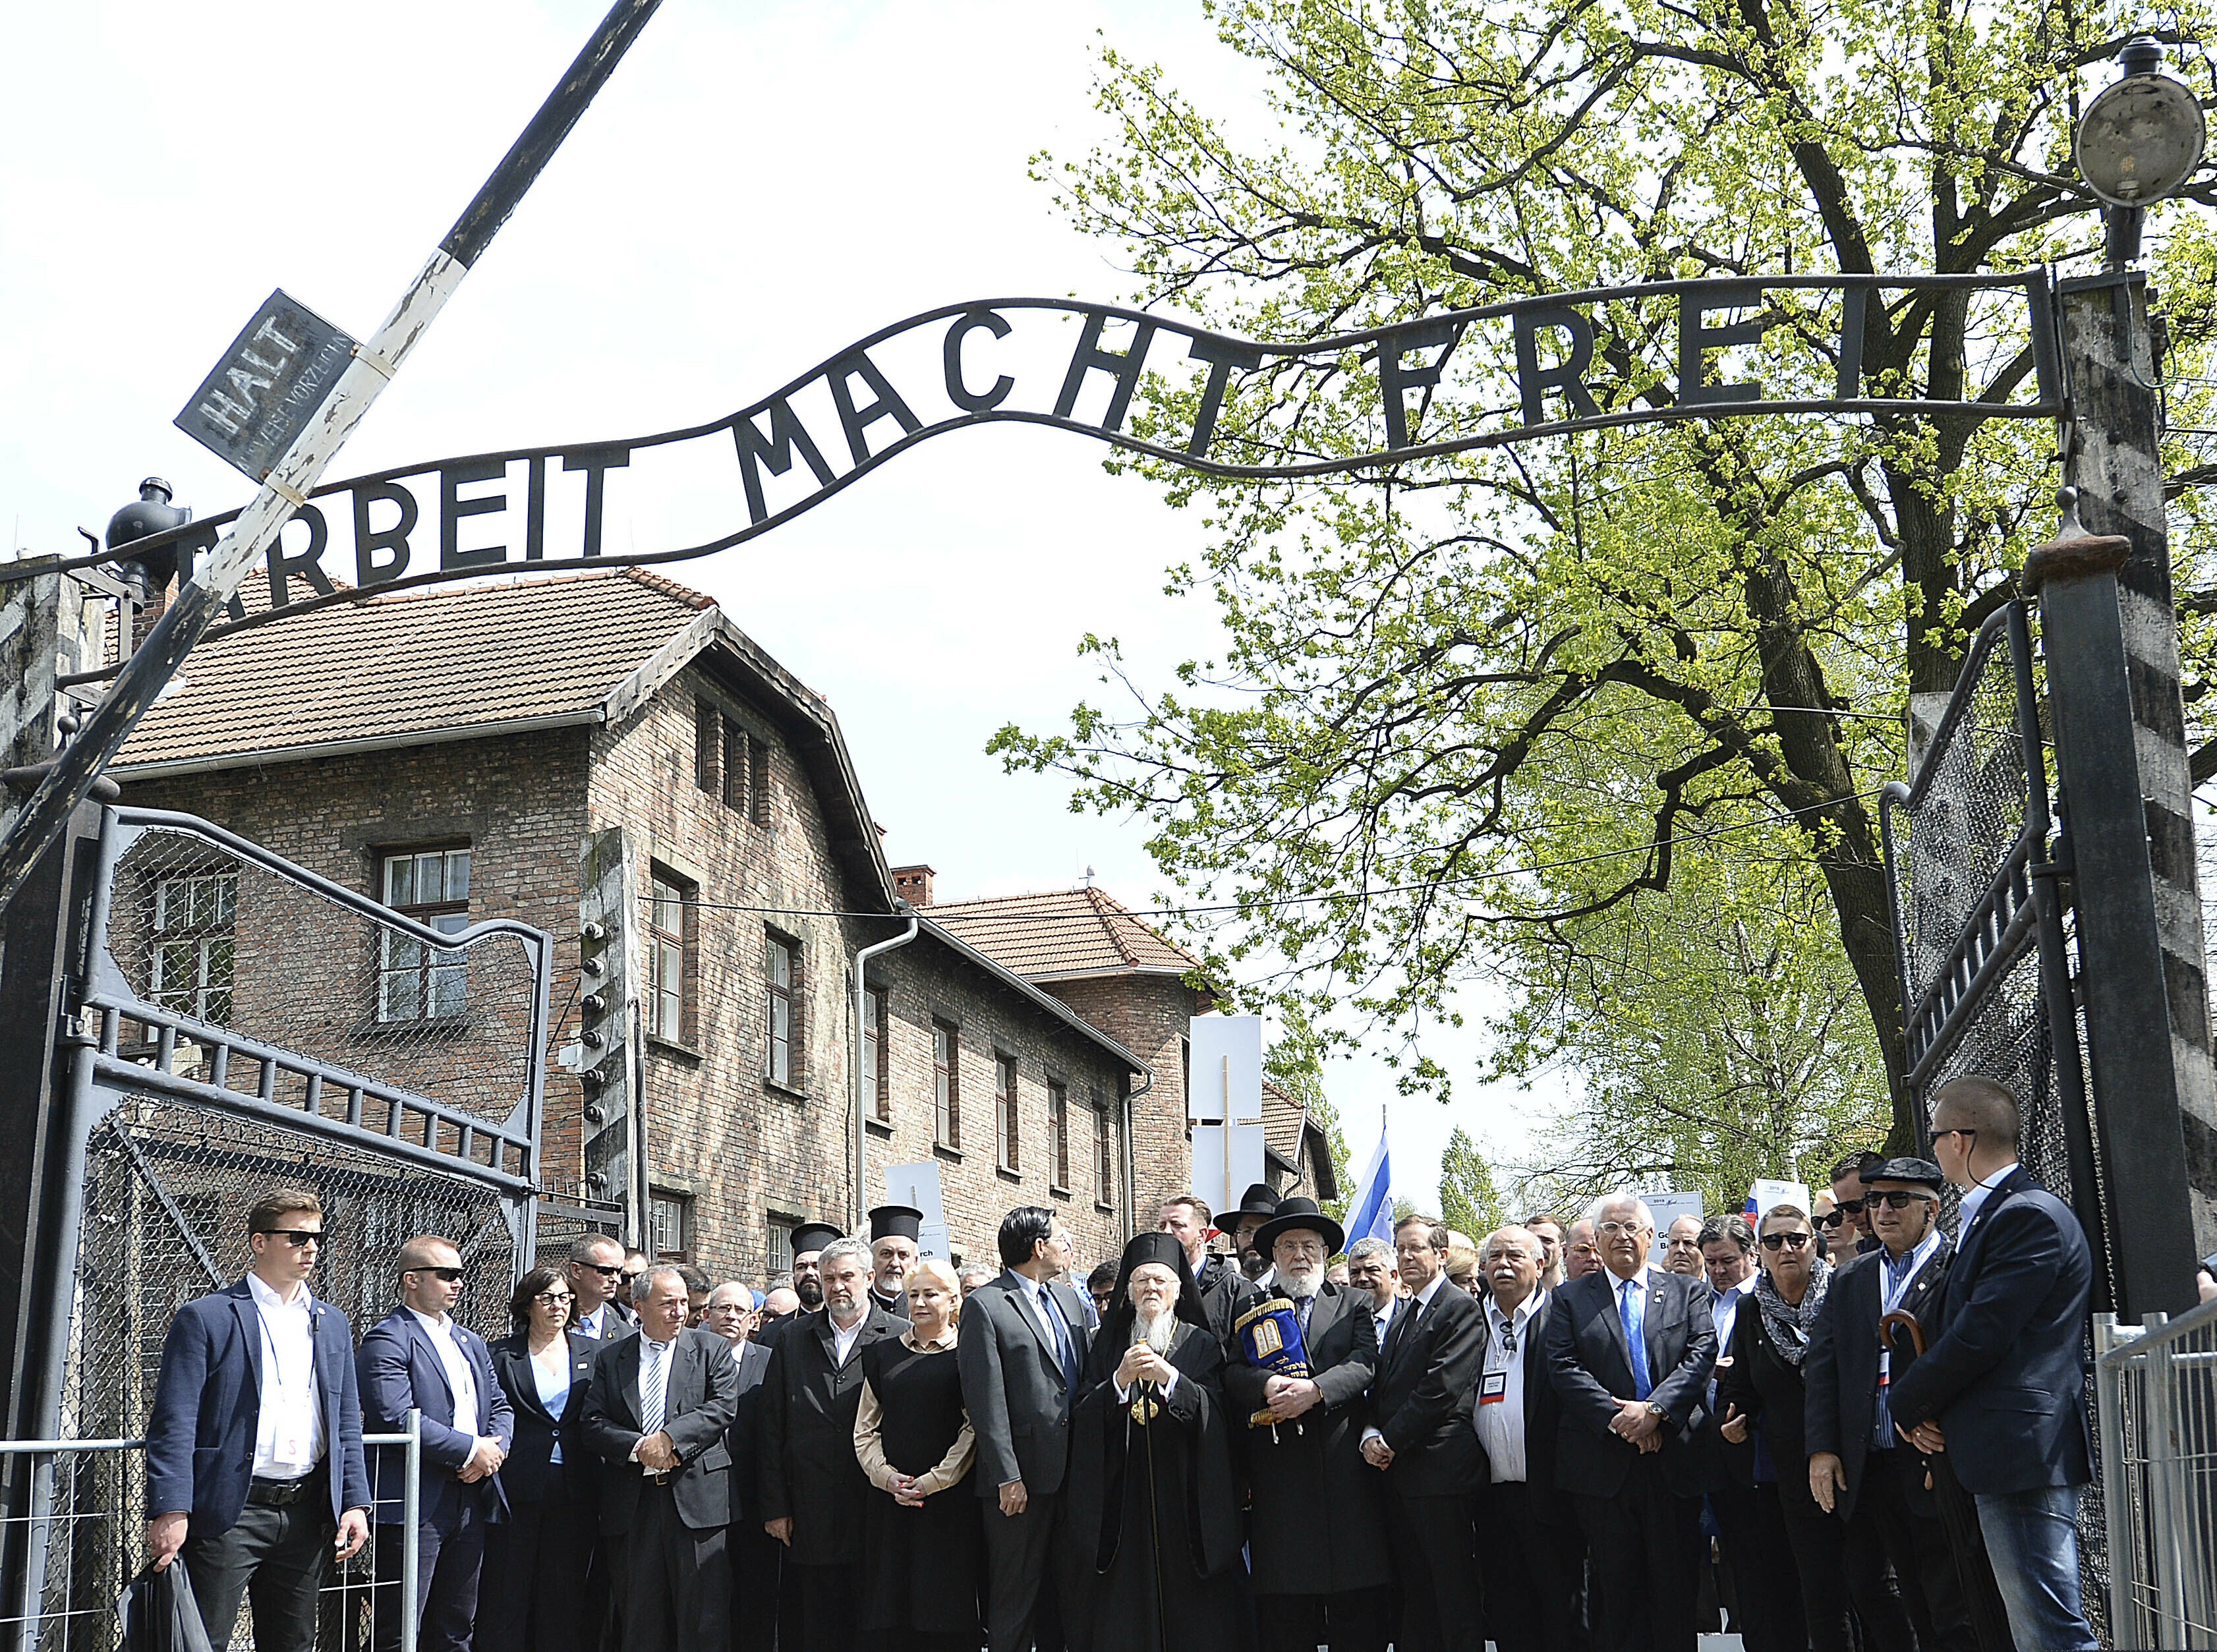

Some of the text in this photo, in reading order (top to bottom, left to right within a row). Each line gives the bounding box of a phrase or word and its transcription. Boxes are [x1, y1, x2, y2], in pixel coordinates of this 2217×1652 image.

[199, 315, 299, 435] HALT
[732, 308, 1261, 526] MACHT
[1378, 286, 1866, 449] FREI
